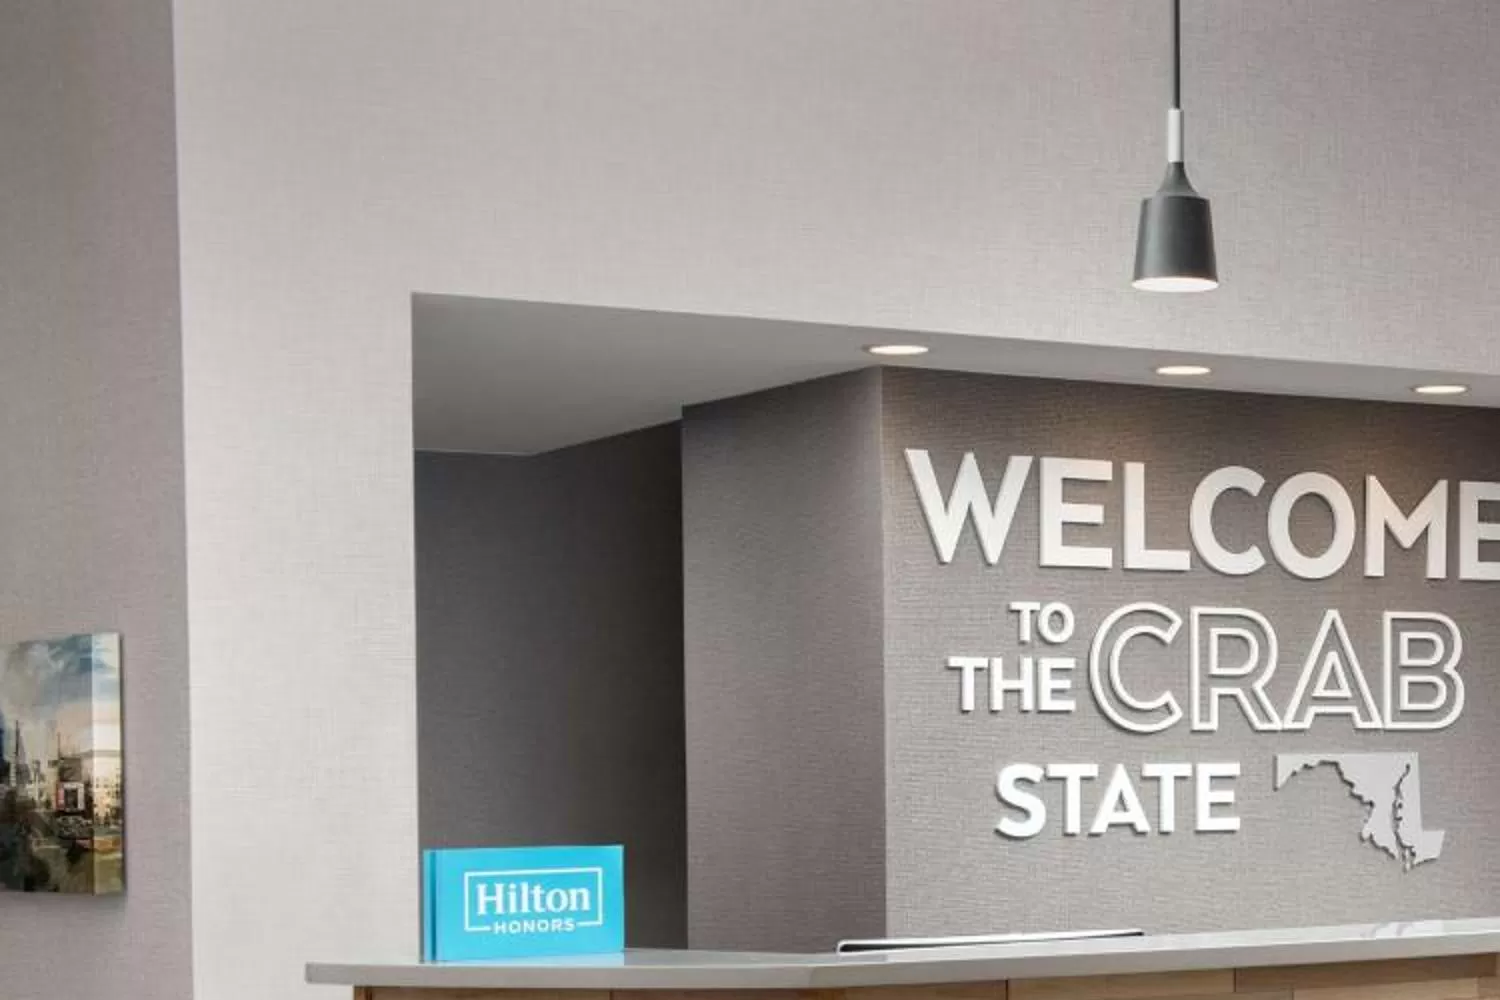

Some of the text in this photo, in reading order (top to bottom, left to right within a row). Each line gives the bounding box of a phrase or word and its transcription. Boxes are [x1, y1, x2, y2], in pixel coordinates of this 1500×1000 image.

[1010, 602, 1075, 644] TO
[948, 602, 1466, 734] THE CRAB
[995, 762, 1241, 838] STATE
[476, 881, 592, 916] Hilton
[494, 918, 576, 935] HONORS
